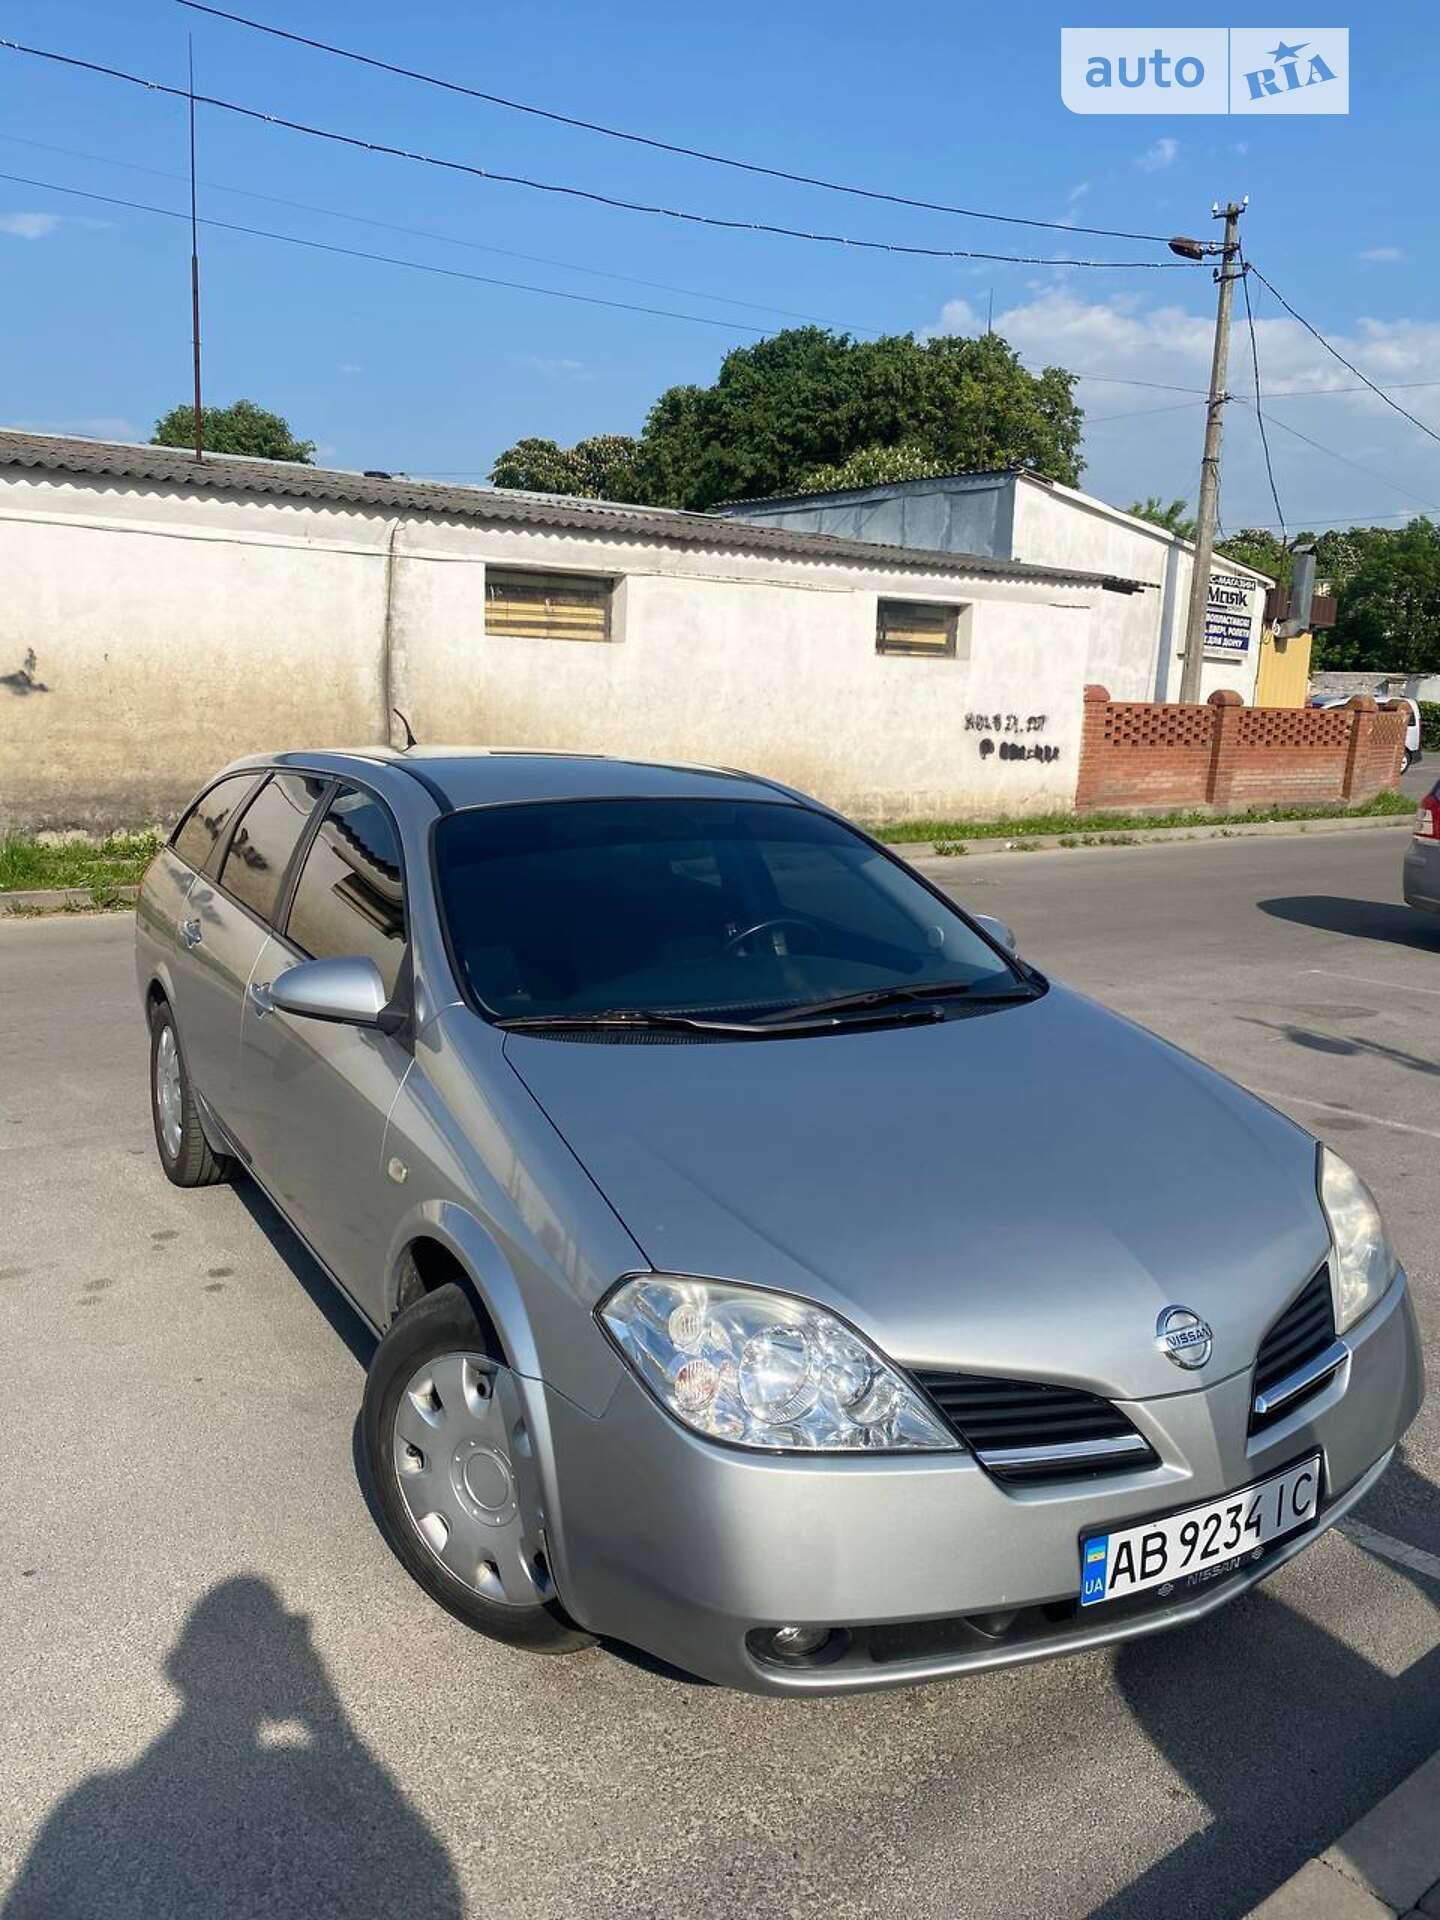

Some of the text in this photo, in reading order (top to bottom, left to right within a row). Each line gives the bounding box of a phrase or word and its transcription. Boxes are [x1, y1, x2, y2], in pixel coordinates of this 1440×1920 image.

[1209, 575, 1255, 590] С-МАГАЗИН
[1166, 1327, 1211, 1347] NISSAN
[1109, 1473, 1312, 1589] AB 9234 IC
[1187, 1556, 1240, 1587] NISSAN
[1085, 1579, 1103, 1595] UA
